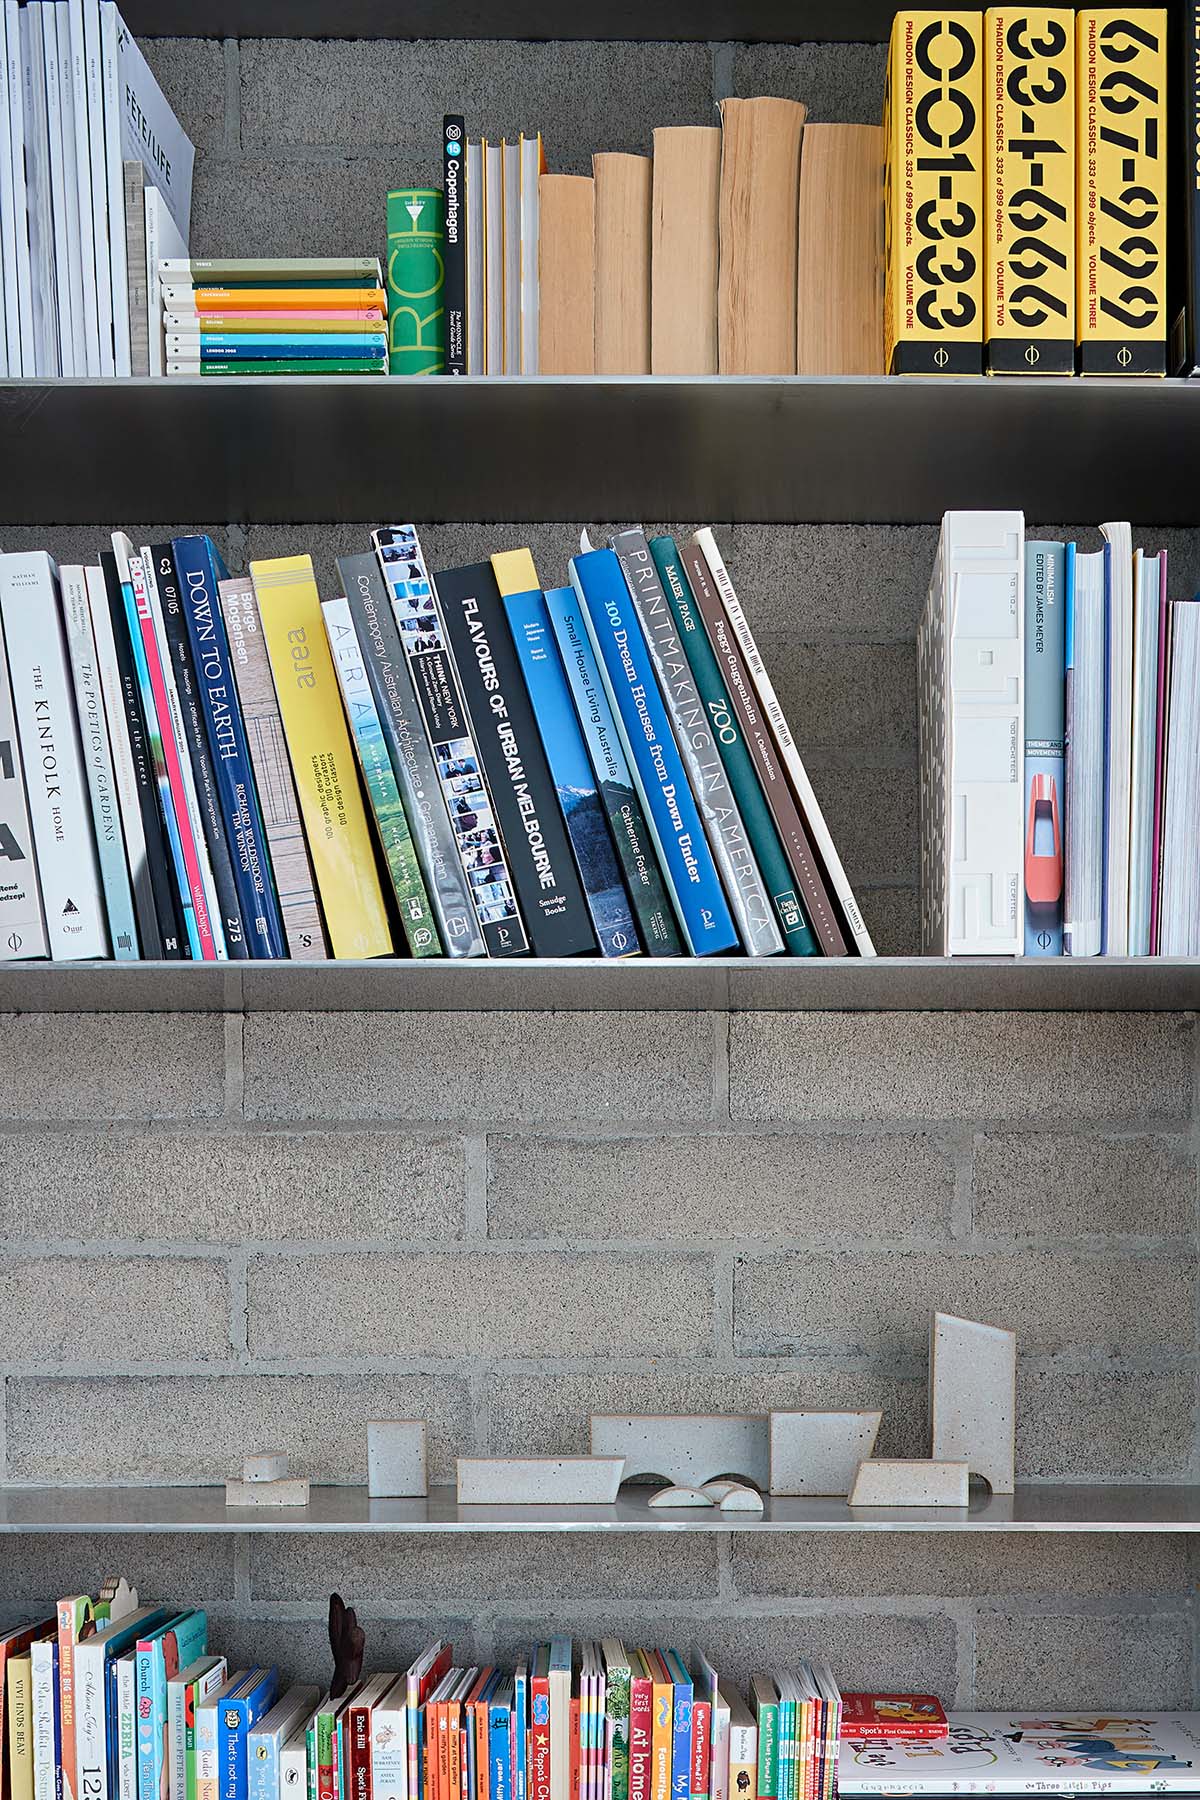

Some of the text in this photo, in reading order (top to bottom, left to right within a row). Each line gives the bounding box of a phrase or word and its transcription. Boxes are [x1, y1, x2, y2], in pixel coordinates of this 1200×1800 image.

[995, 17, 1003, 61] PHAIDON
[995, 64, 1003, 100] DESIGN
[995, 104, 1003, 153] CLASSICS.
[904, 20, 913, 328] PHAIDON DESIGN CLASSICS. 333 of 999 objects. VOLUME ONE
[915, 20, 977, 331] 001-333
[995, 156, 1003, 174] 333
[996, 177, 1003, 186] of
[1008, 20, 1066, 326] 334-666
[1088, 180, 1095, 188] of
[1099, 21, 1158, 327] 667-999
[446, 159, 459, 243] Copenhagen
[995, 188, 1003, 205] 999
[994, 209, 1003, 244] objects.
[1087, 211, 1095, 246] objects.
[159, 557, 172, 575] C3
[1036, 584, 1043, 593] BY
[1046, 553, 1054, 604] MINIMALISM
[241, 592, 257, 632] Børge
[723, 588, 735, 603] LIFE
[226, 594, 248, 664] Mogensen
[186, 570, 238, 759] DOWN TO EARTH
[287, 627, 316, 688] area
[332, 624, 376, 735] AERIAL
[177, 642, 198, 727] Hotels Housings Offices
[432, 653, 458, 728] THINK NEW YORK
[563, 615, 617, 776] Small House Living Australia
[714, 620, 732, 654] Peggy
[727, 655, 756, 724] Guggenheim
[757, 738, 775, 780] Celebration
[124, 676, 147, 785] EDGE of the trees
[357, 575, 439, 847] Contemporary Australian Architecture Graham
[708, 698, 737, 744] ZOO
[32, 665, 64, 842] THE KINFOLK HOME
[81, 663, 115, 841] The POETICS of GARDENS
[462, 598, 555, 889] FLAVOURS OF URBAN MELBOURNE
[604, 600, 700, 883] 100 Dream Houses from Down Under
[631, 550, 772, 931] PRINTMAKING IN AMERICA
[311, 755, 332, 824] graphic designers
[318, 753, 334, 801] 010 curators
[326, 752, 344, 810] design classics
[369, 744, 388, 797] AUSTRALIA
[231, 810, 250, 871] TIM WINTON
[235, 783, 264, 894] RICHARD WOLDENDORP
[620, 805, 650, 885] Catherine Foster
[190, 885, 211, 937] whitechapel
[538, 895, 566, 907] Smudge
[544, 905, 566, 916] Books
[653, 911, 668, 939] PENGUIN
[847, 902, 862, 930] HAMLYN
[227, 917, 242, 942] 273
[62, 1645, 72, 1725] EMMA'S BIG SEARCH
[140, 1658, 150, 1691] Church
[15, 1679, 24, 1755] VIVI BEAN
[121, 1712, 132, 1759] ZEBRA
[356, 1715, 365, 1732] Eric
[201, 1749, 212, 1777] Rudie
[225, 1733, 238, 1798] That's not my
[534, 1747, 548, 1781] Peppa's
[632, 1727, 649, 1800] At home
[694, 1709, 704, 1780] What's That Sound?
[764, 1757, 772, 1782] Sound?
[765, 1738, 773, 1755] That
[357, 1766, 366, 1790] Spot's
[675, 1775, 687, 1792] My
